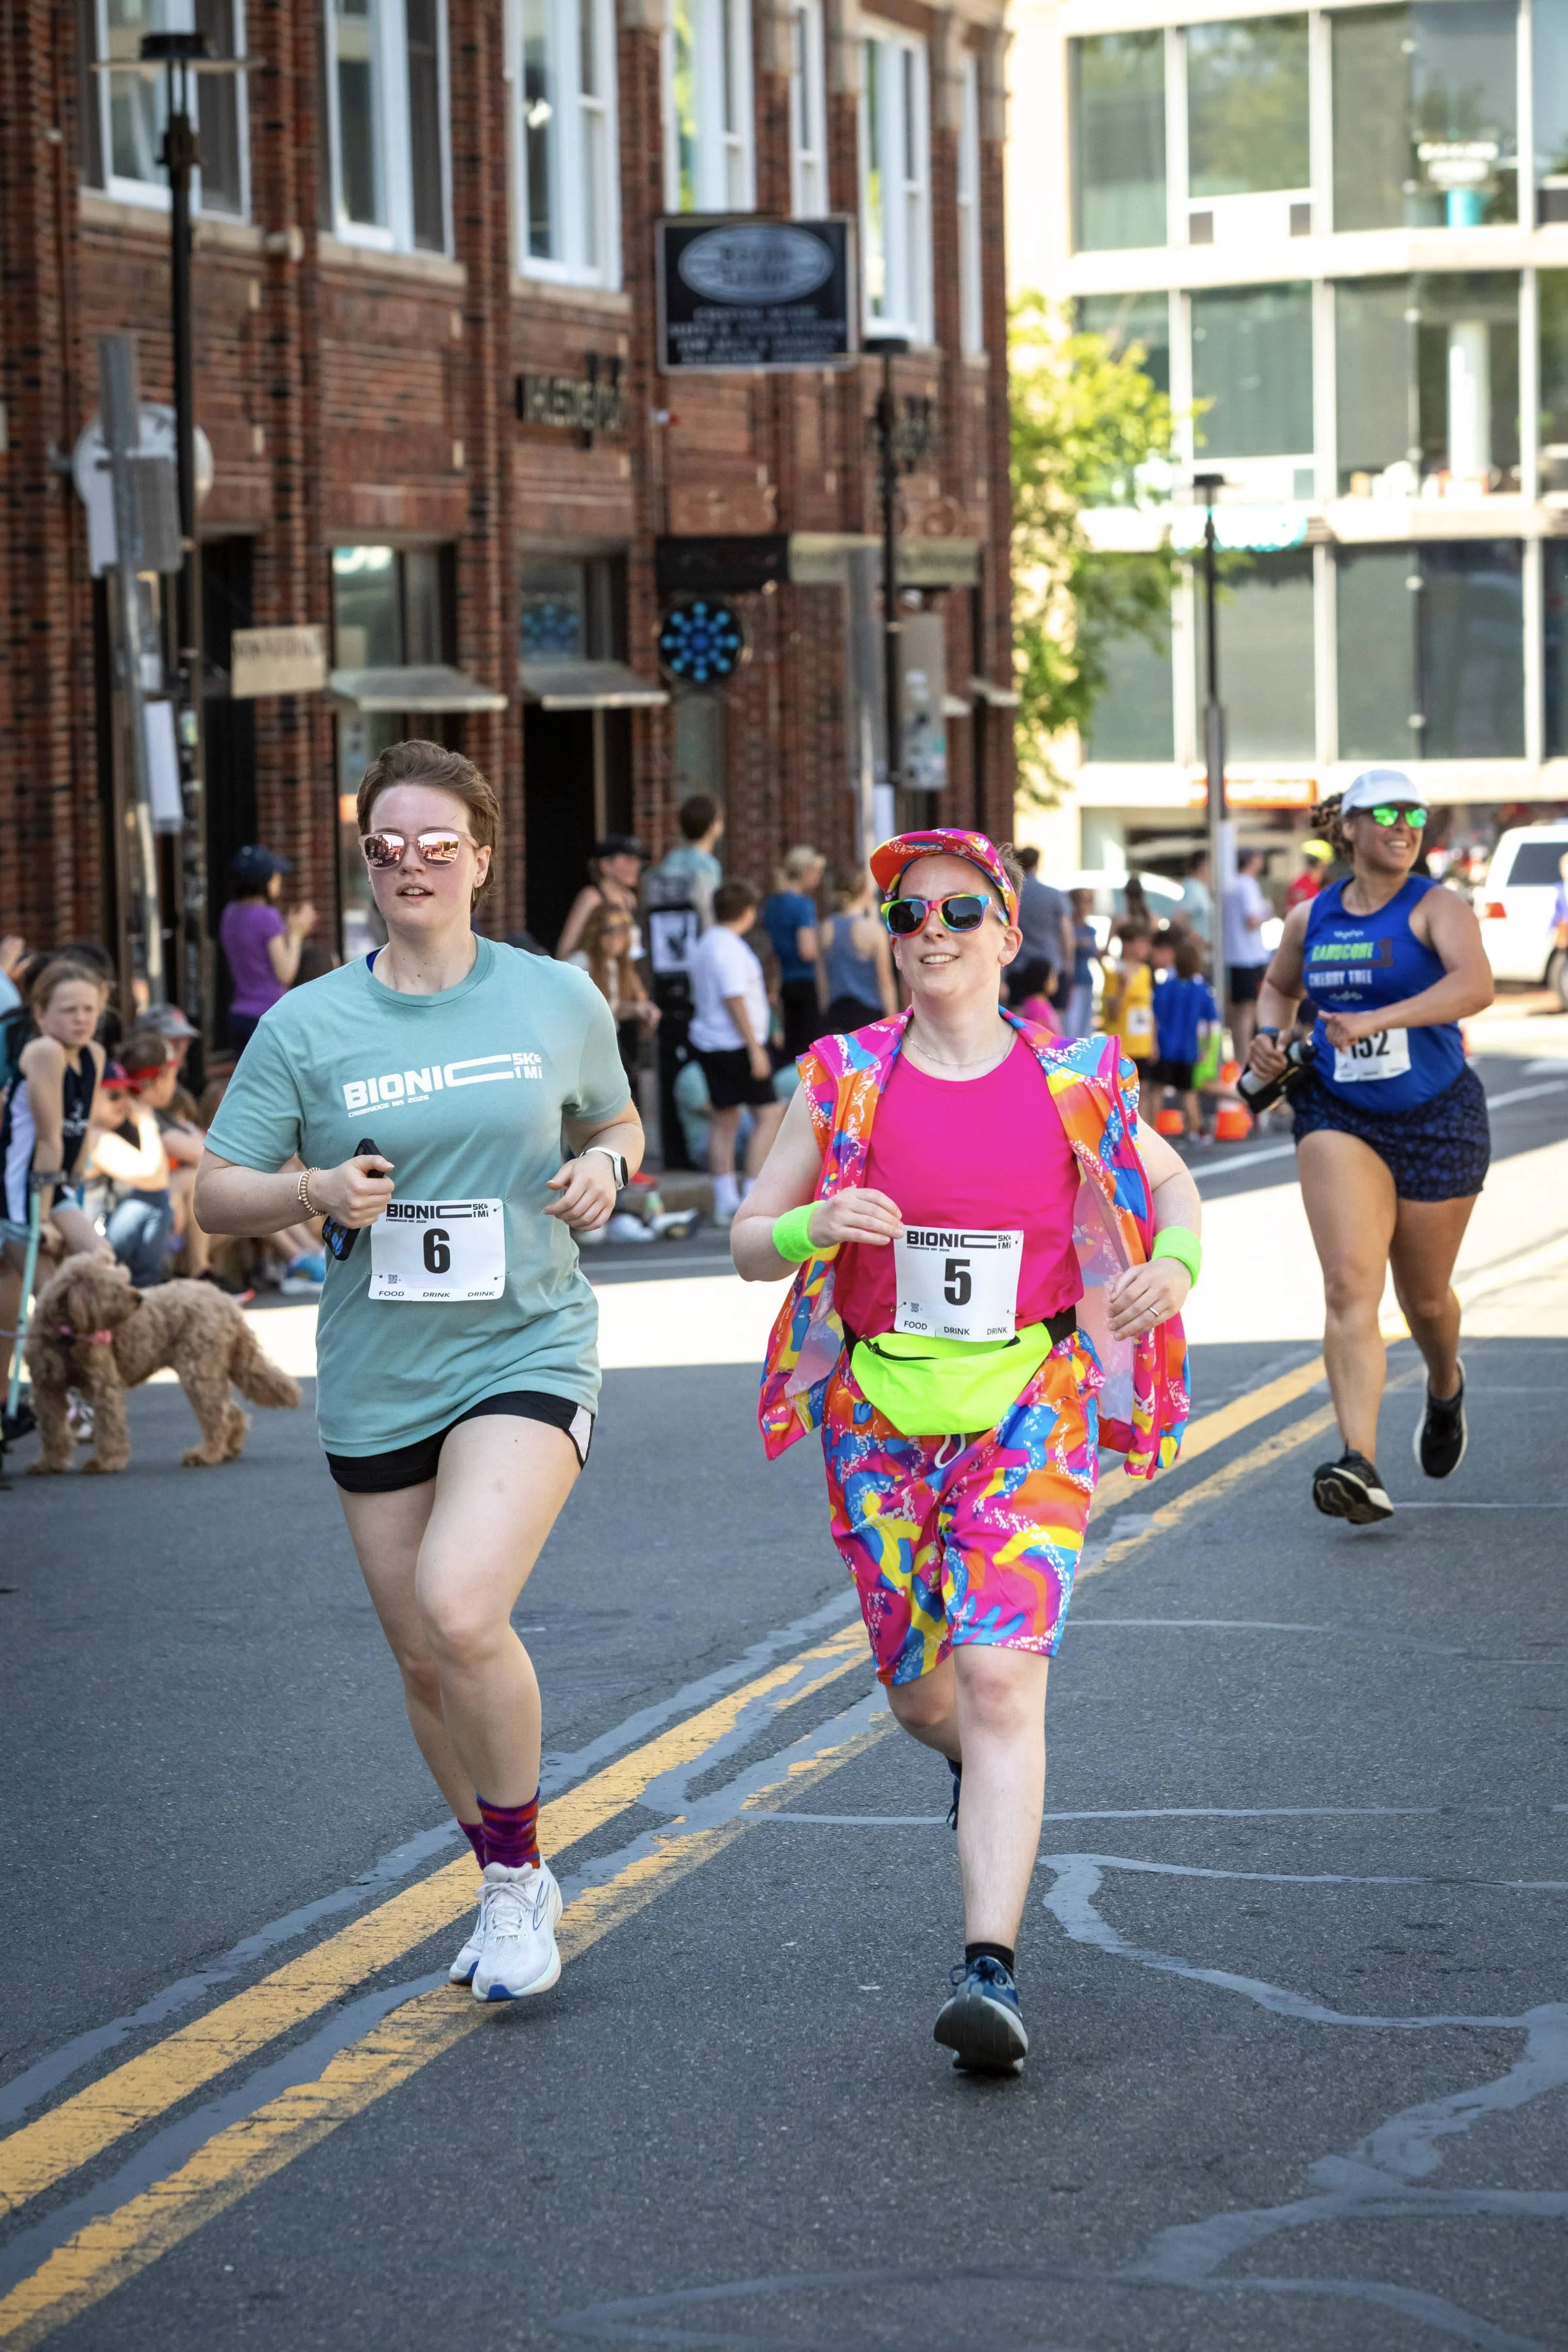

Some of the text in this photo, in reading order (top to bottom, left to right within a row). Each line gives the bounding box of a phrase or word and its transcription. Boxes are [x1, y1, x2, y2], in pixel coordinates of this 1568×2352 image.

[512, 1053, 542, 1065] 5K&
[343, 1054, 514, 1110] BIONIC
[386, 1203, 472, 1218] BIONIC
[907, 1230, 997, 1249] BIONIC
[423, 1228, 451, 1274] 6
[944, 1258, 972, 1305] 5
[904, 1320, 1007, 1335] FOOD DRINK DRINK
